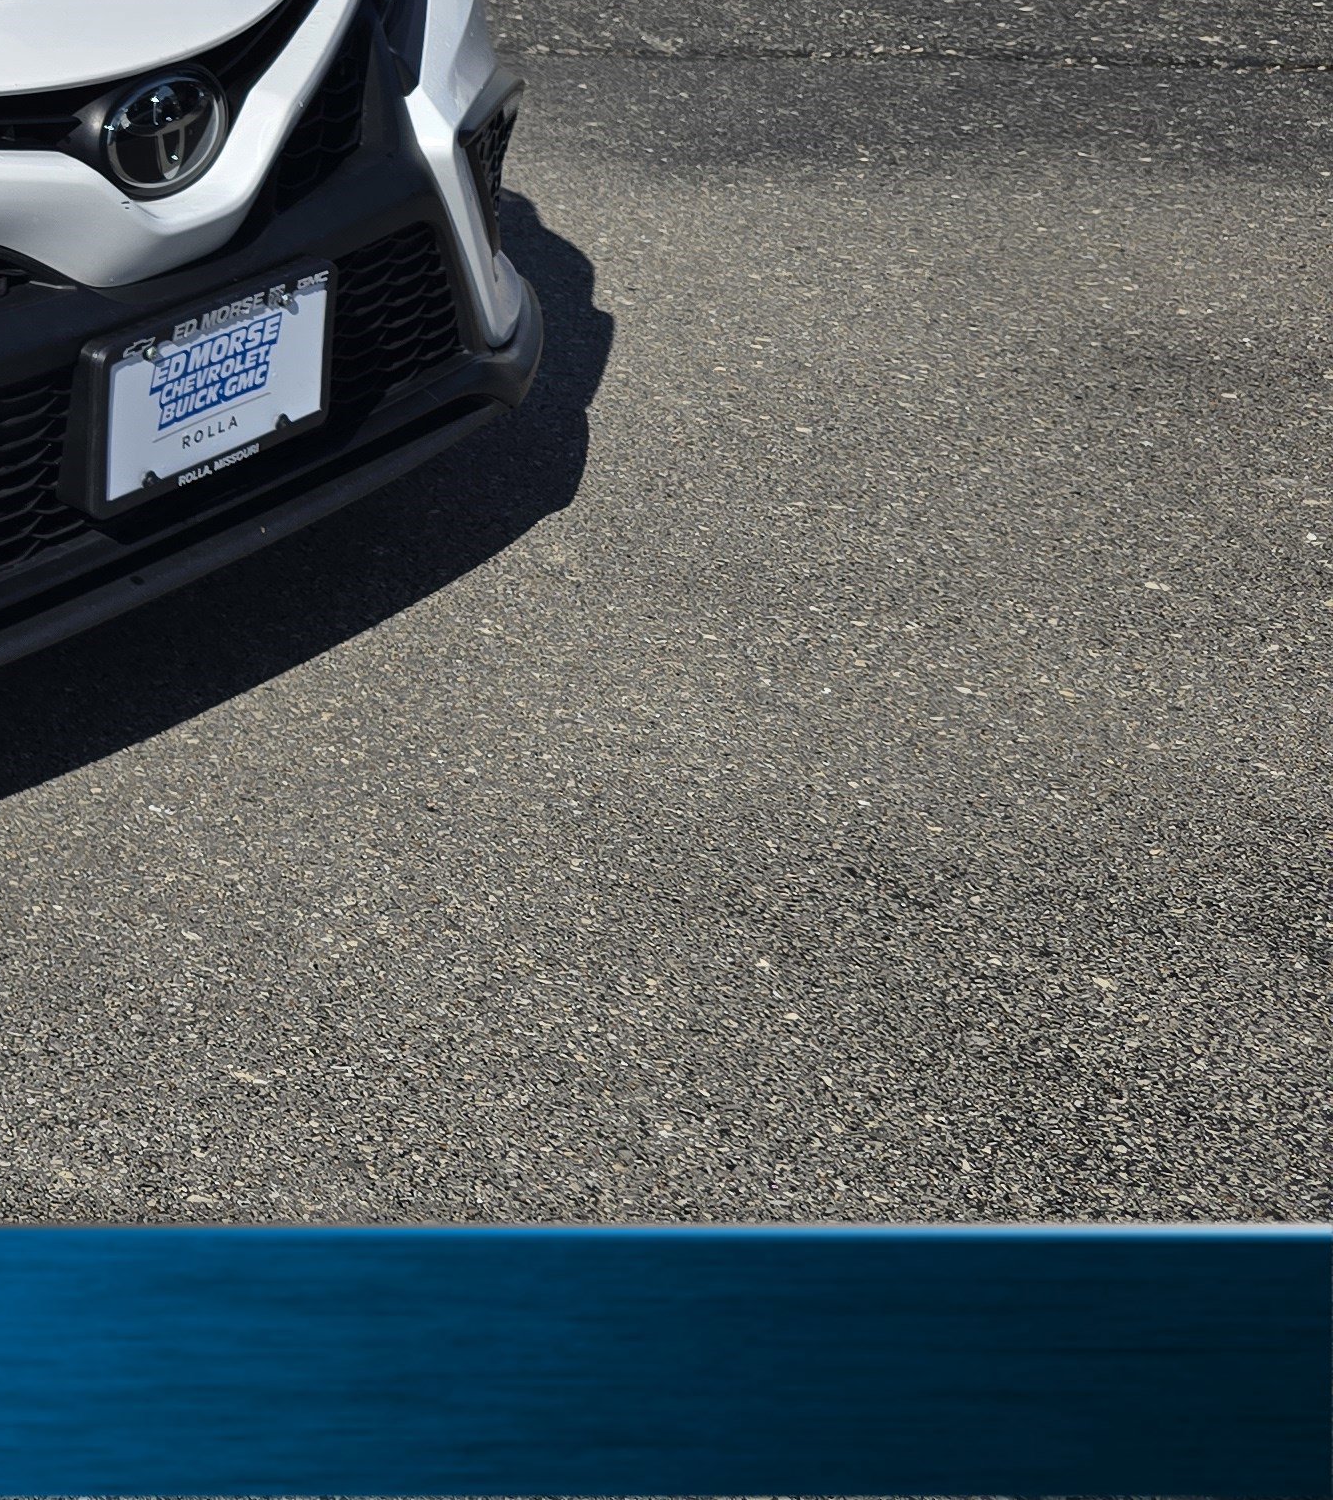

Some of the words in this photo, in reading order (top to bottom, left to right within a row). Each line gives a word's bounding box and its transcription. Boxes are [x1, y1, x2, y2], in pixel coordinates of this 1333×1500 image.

[172, 318, 198, 343] ED
[200, 291, 265, 332] MORSE
[297, 270, 329, 290] GMC
[150, 355, 186, 390] ED
[188, 314, 281, 373] MORSE
[160, 346, 271, 405] CHEVROLET
[182, 415, 239, 450] ROLLA
[213, 443, 260, 472] MISSOURI
